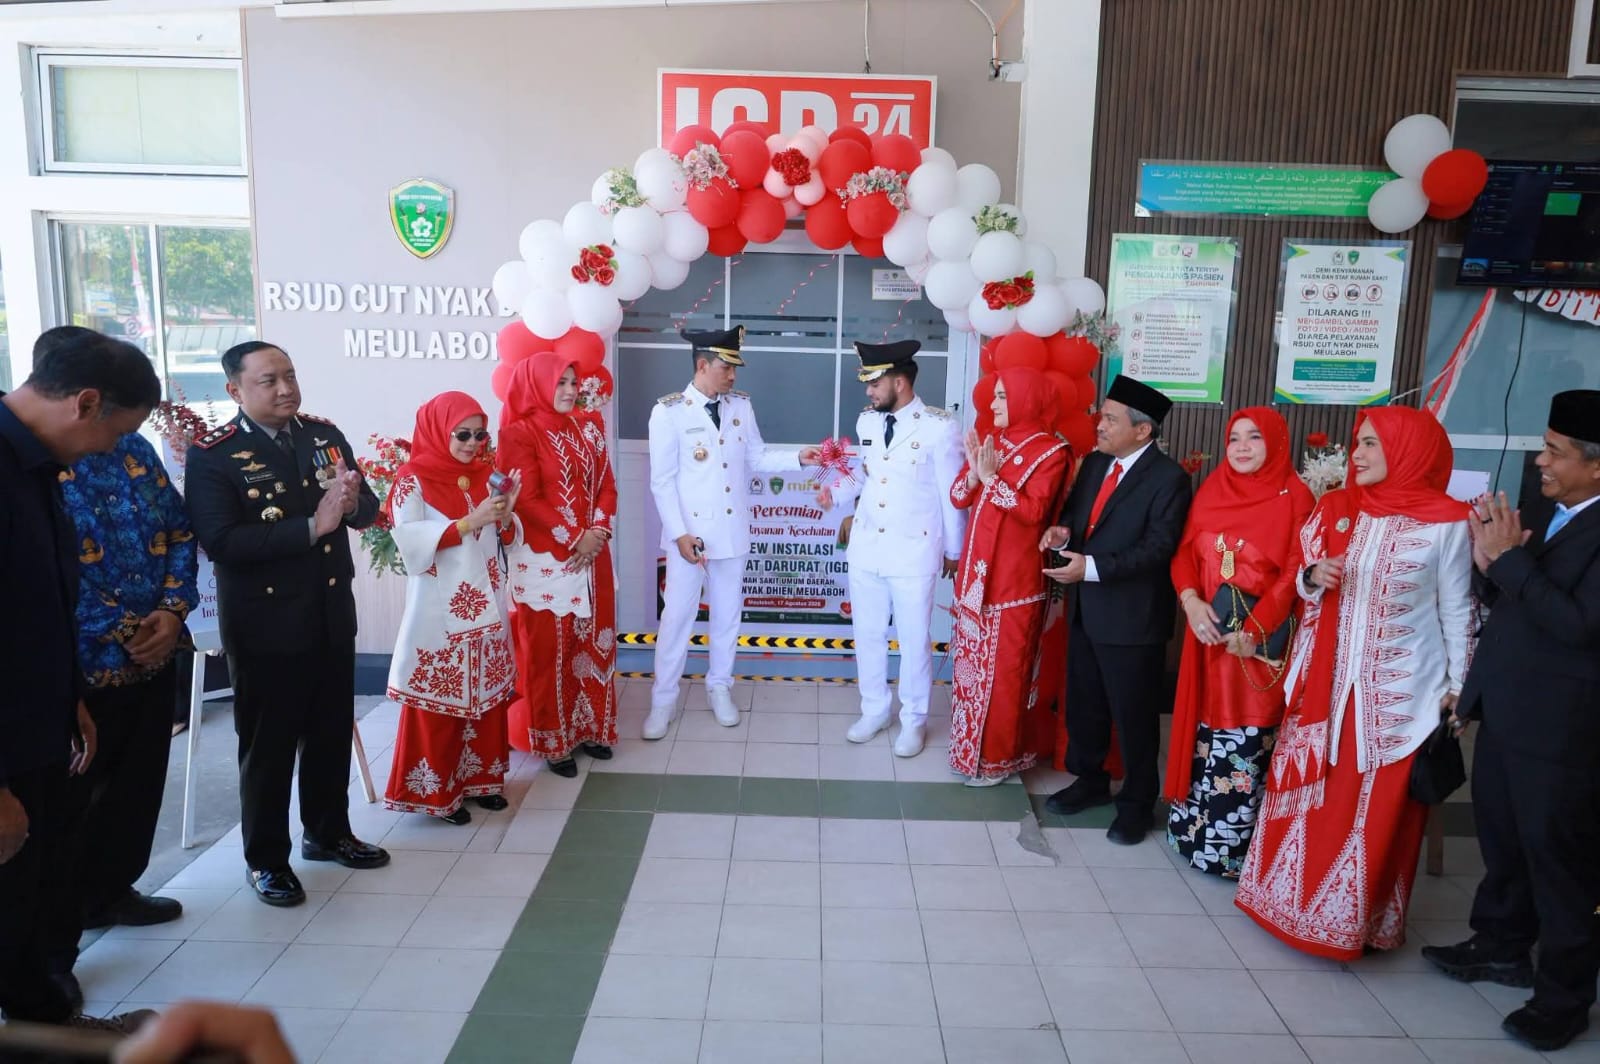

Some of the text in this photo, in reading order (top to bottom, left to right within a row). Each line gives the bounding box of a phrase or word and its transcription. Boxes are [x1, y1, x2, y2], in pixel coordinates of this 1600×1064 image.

[853, 103, 912, 138] 24
[1190, 273, 1224, 281] PASIEN
[264, 282, 492, 317] RSUD CUT NYAK
[1308, 308, 1371, 317] DILARANG !!!
[750, 504, 823, 520] Peresmian
[787, 525, 836, 537] Kesehatan
[772, 543, 834, 555] INSTALASI
[765, 560, 820, 572] DARURAT
[781, 577, 805, 585] UMUM
[741, 586, 845, 597] NYAK DHIEN MEULABOH
